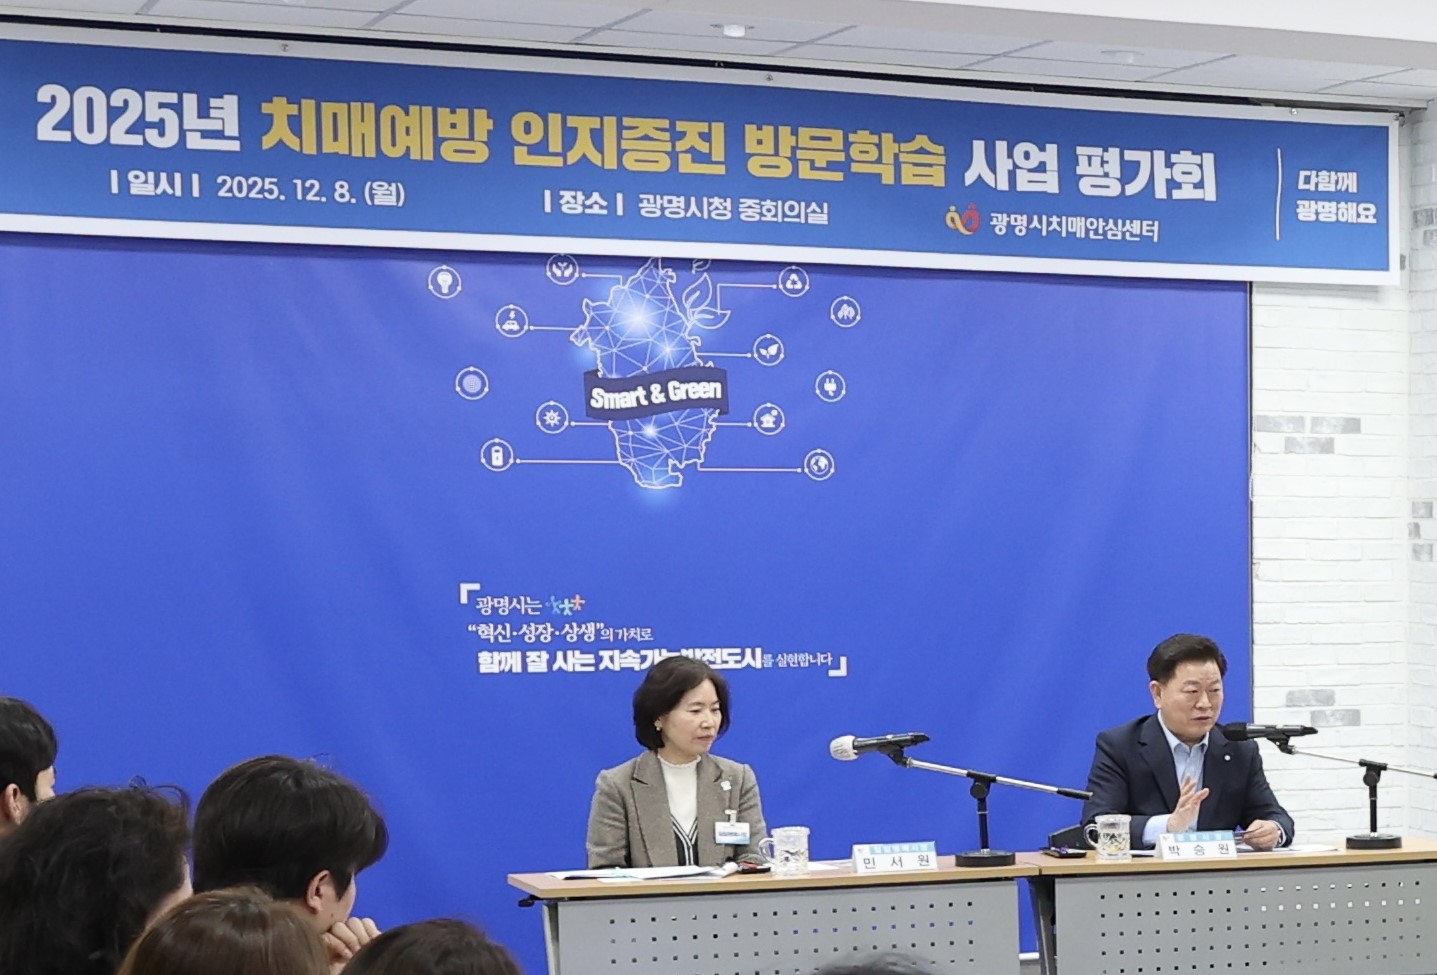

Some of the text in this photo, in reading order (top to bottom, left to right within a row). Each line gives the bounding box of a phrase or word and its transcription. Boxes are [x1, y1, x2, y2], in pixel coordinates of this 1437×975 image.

[35, 83, 1218, 203] 2025년 치매예방 인지증진 방문학습 사업 평가회
[127, 169, 406, 209] 일시 2025. 12. 8. (월)
[1296, 168, 1359, 195] 다함께
[558, 189, 830, 227] 장소 광명시청 중회의실
[1294, 198, 1379, 226] 광명해요
[989, 211, 1160, 243] 광명시치매안심센터
[590, 377, 723, 411] Smart & Green
[475, 595, 543, 616] 광명시는
[477, 650, 522, 675] 함께
[525, 649, 550, 674] 잘
[552, 649, 597, 673] 사는
[776, 652, 834, 668] 실현합니다
